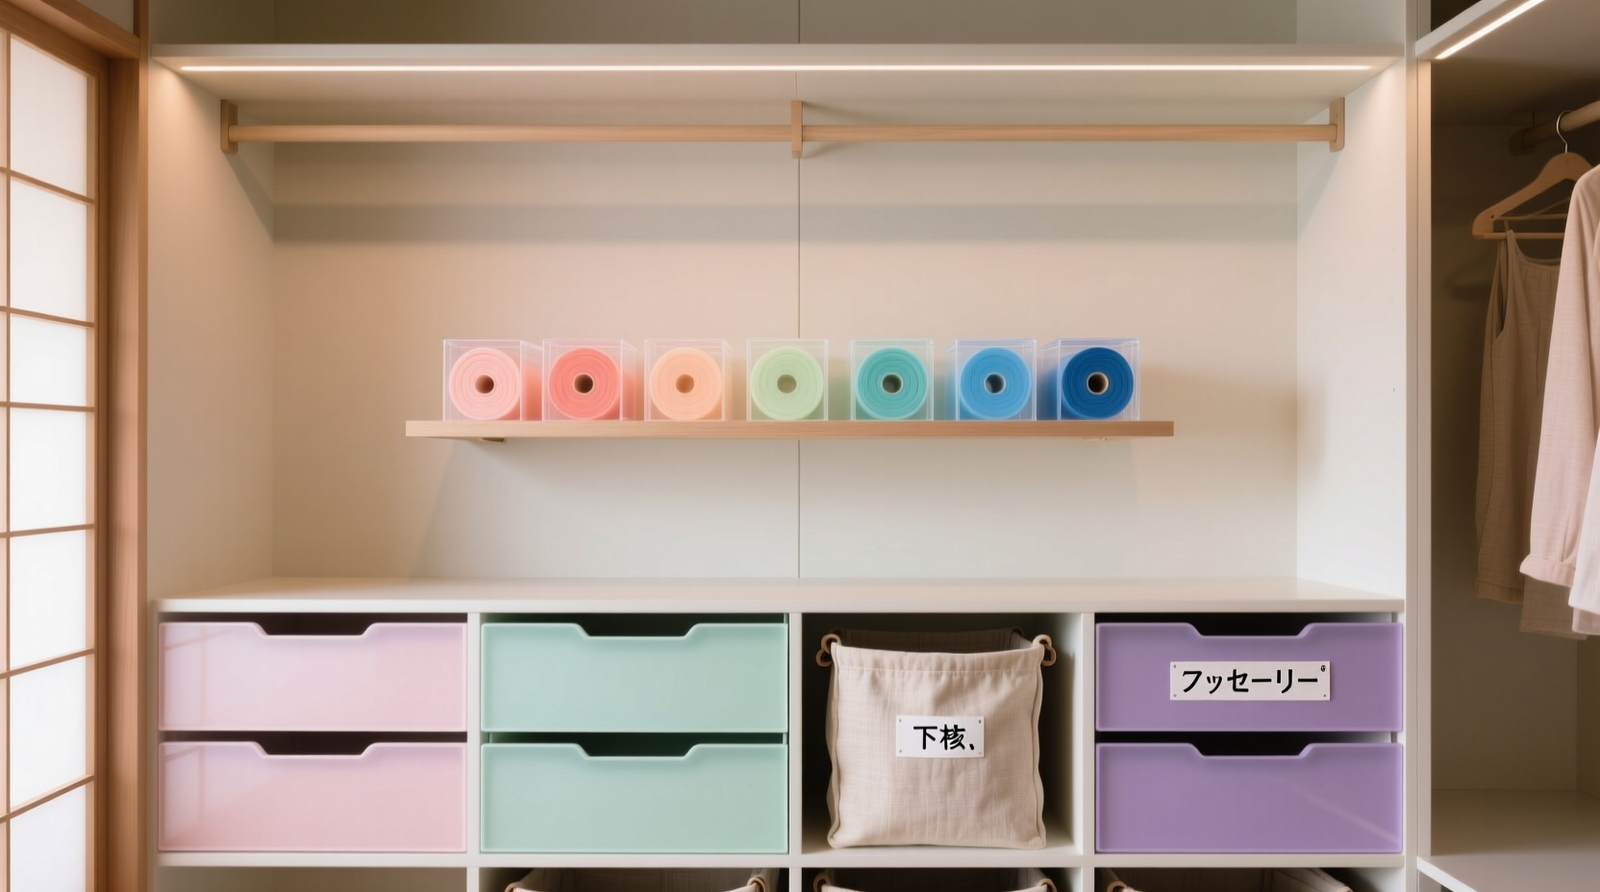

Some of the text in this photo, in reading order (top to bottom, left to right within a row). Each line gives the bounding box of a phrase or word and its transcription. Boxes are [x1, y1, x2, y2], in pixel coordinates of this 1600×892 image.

[1182, 668, 1319, 695] フッセーリー
